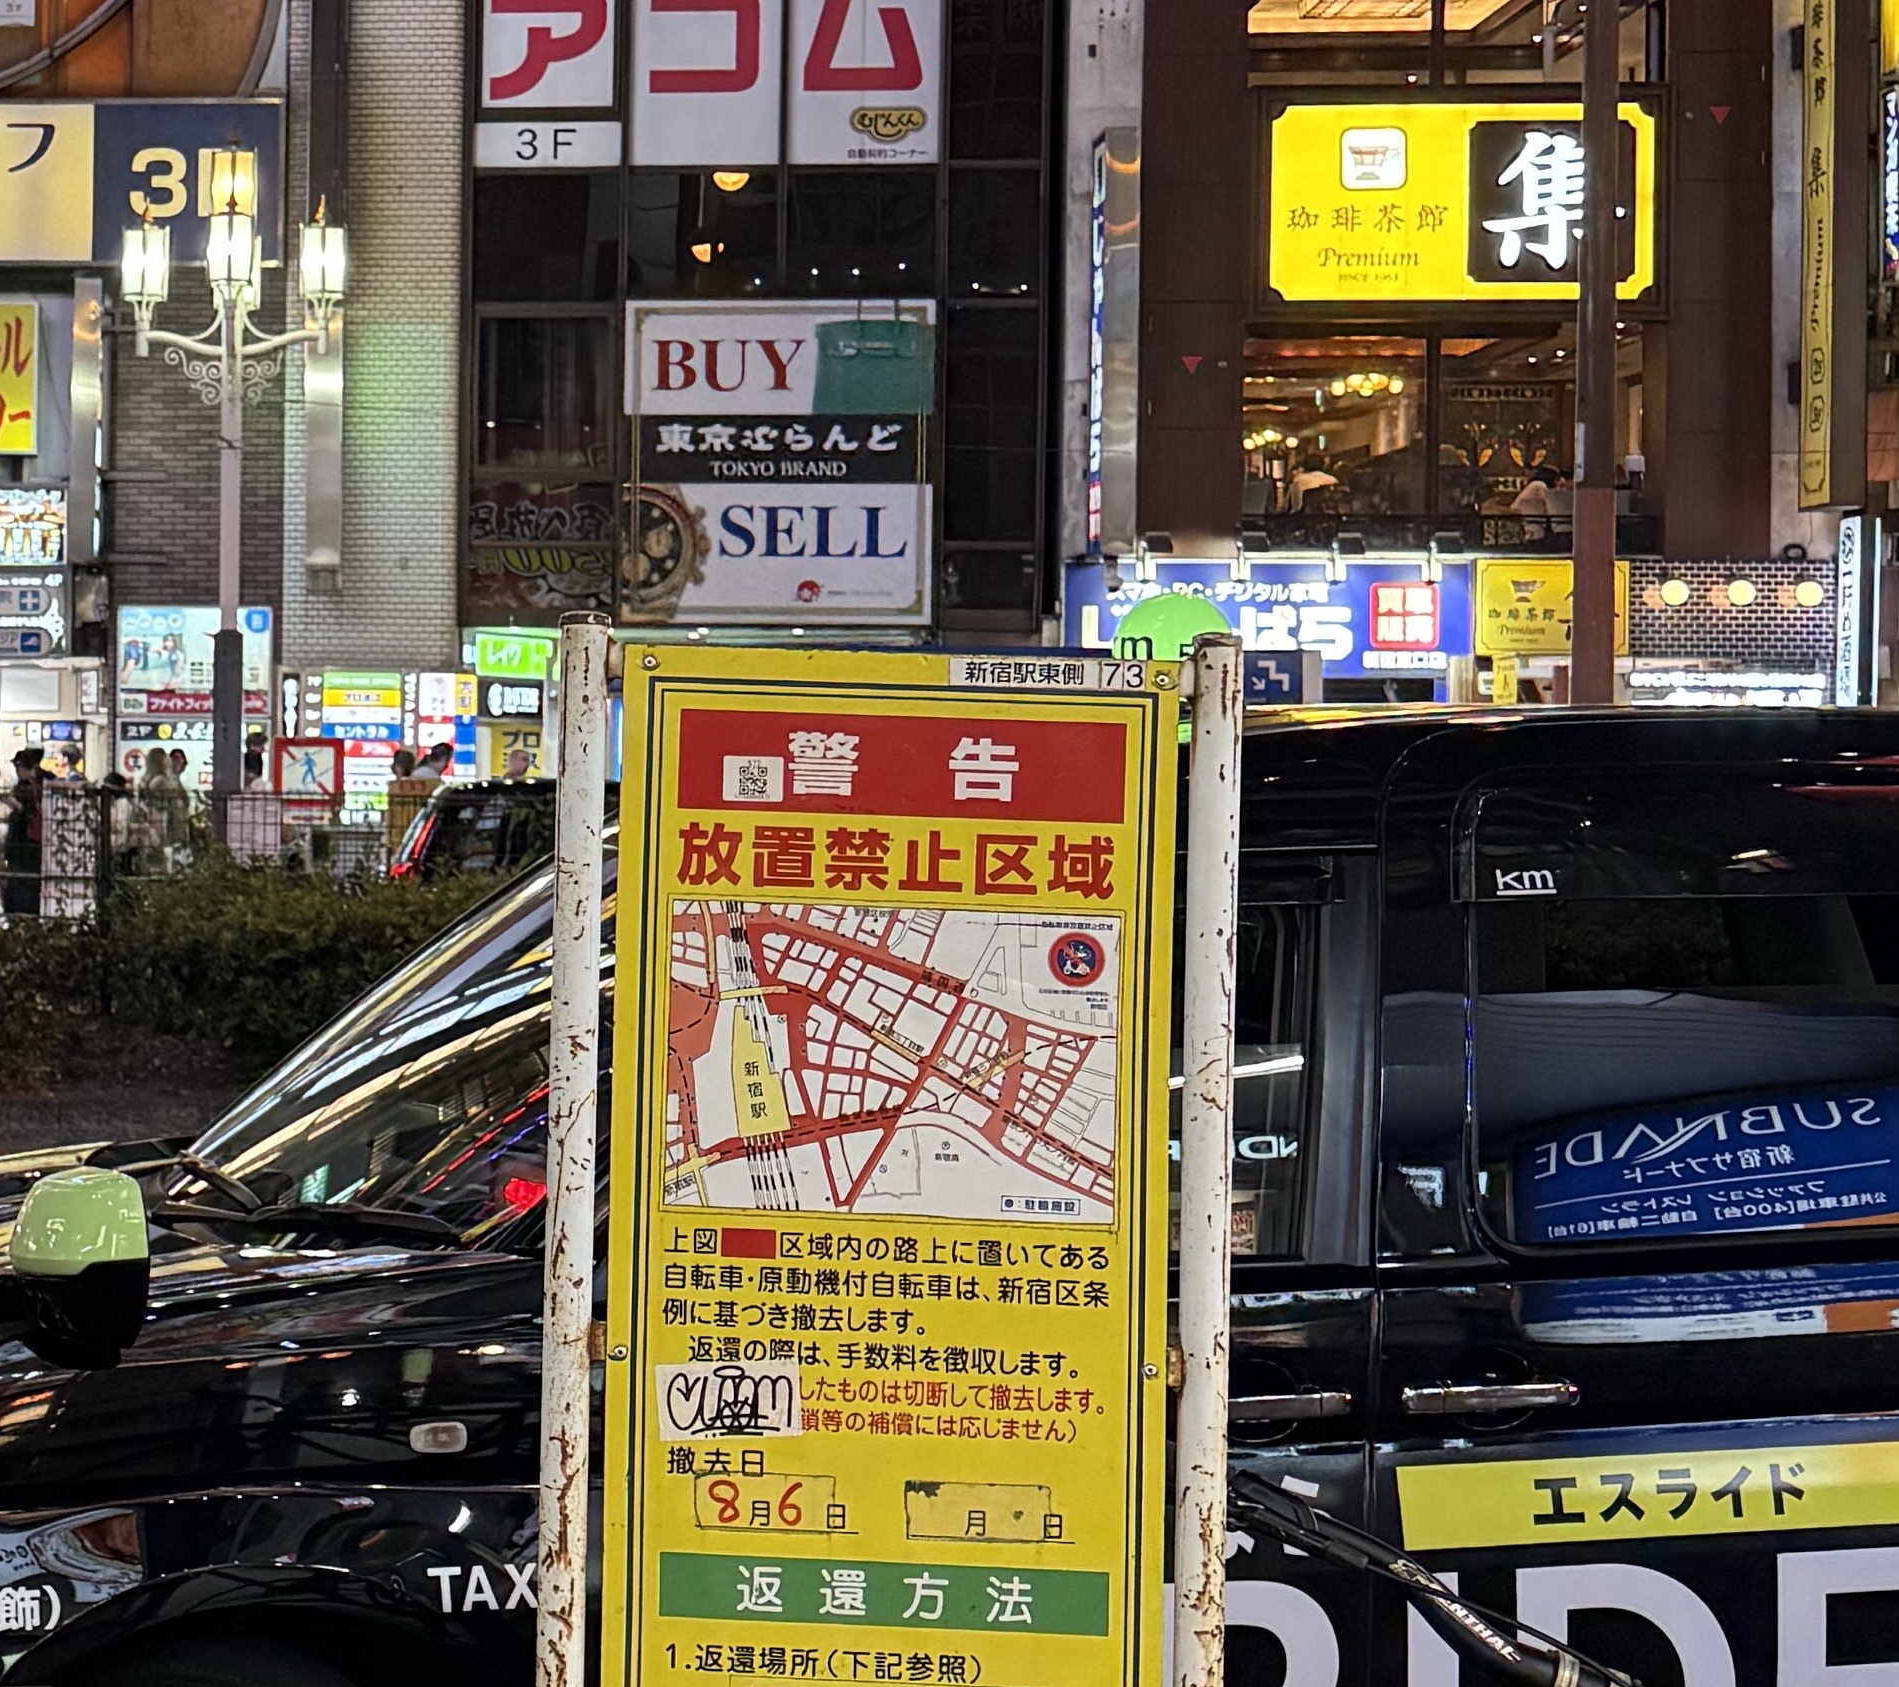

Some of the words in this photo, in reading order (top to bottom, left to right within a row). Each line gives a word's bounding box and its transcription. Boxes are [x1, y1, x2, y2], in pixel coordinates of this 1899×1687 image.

[514, 128, 578, 162] 3F
[846, 146, 929, 160] 自動契約コーナー
[1286, 204, 1449, 234] 珈琲茶館
[1316, 246, 1421, 271] Premium
[651, 338, 806, 392] BUY
[656, 423, 902, 454] 東京ぶらんど
[709, 460, 775, 478] TOKYO
[779, 460, 847, 478] BRAND
[717, 505, 907, 559] SELL
[964, 662, 1085, 687] 新宿駅東側
[1103, 661, 1143, 689] 73
[788, 730, 1020, 803] 警告
[678, 821, 1117, 900] 放置禁止区域
[1495, 867, 1556, 890] km
[743, 1060, 769, 1120] 新宿駅
[662, 1227, 718, 1255] 上図
[779, 1230, 1111, 1271] 区域内の路上に置いてある
[662, 1262, 1111, 1308] 自転車・原動機付自転車は、新宿区条
[661, 1300, 926, 1338] 例に基づき撤去します。
[687, 1335, 1080, 1380] 返還の際は、手数料を徴収します。
[666, 1446, 765, 1476] 撤去日
[1533, 1462, 1806, 1526] エスライド
[965, 1510, 987, 1537] 月
[736, 1565, 1034, 1625] 返還方法
[666, 1643, 983, 1686] 1.返還場所（下記参照）
